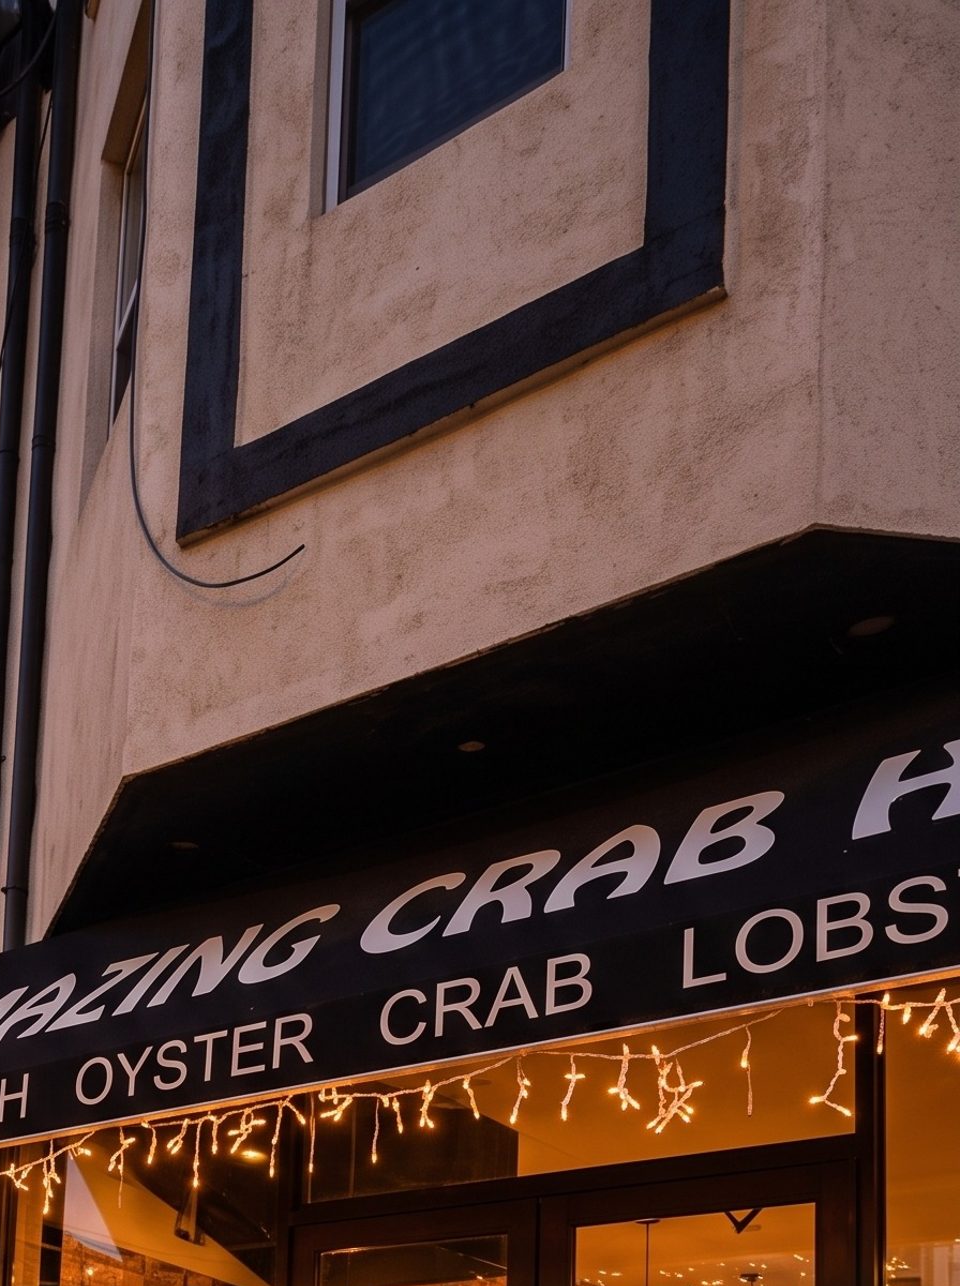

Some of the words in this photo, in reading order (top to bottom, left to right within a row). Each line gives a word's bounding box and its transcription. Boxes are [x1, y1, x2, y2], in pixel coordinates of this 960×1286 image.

[359, 790, 785, 954] CRAB
[74, 1012, 315, 1106] OYSTER
[379, 952, 594, 1046] CRAB
[682, 869, 960, 989] LOBS
